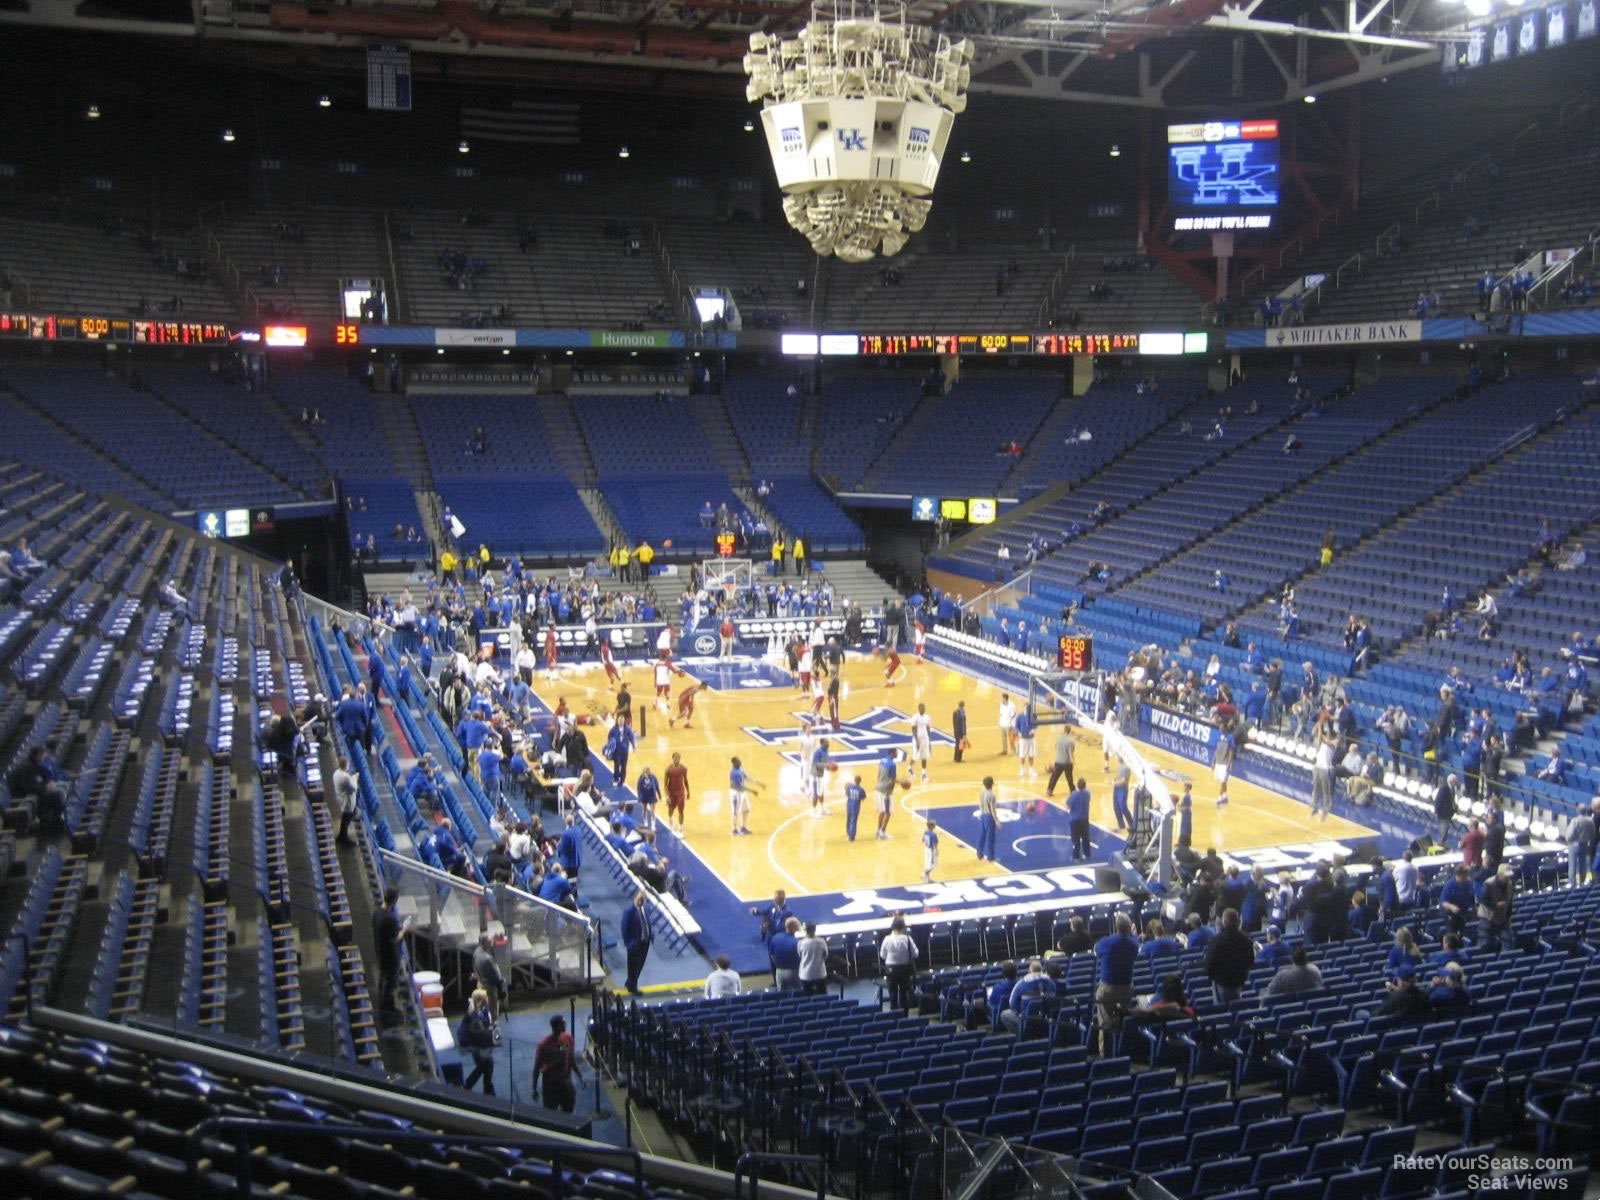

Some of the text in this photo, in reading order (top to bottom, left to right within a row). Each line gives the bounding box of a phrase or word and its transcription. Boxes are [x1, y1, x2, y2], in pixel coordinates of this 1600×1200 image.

[836, 128, 868, 150] UK
[906, 143, 927, 154] RUPP
[1171, 143, 1277, 205] UK
[336, 325, 358, 343] 35
[473, 335, 504, 343] verizon
[602, 333, 655, 346] Humana
[1291, 324, 1409, 343] WHITAKER BANK
[1060, 638, 1085, 651] 60:00
[1063, 650, 1083, 669] 35
[1151, 707, 1211, 743] WILDCATS
